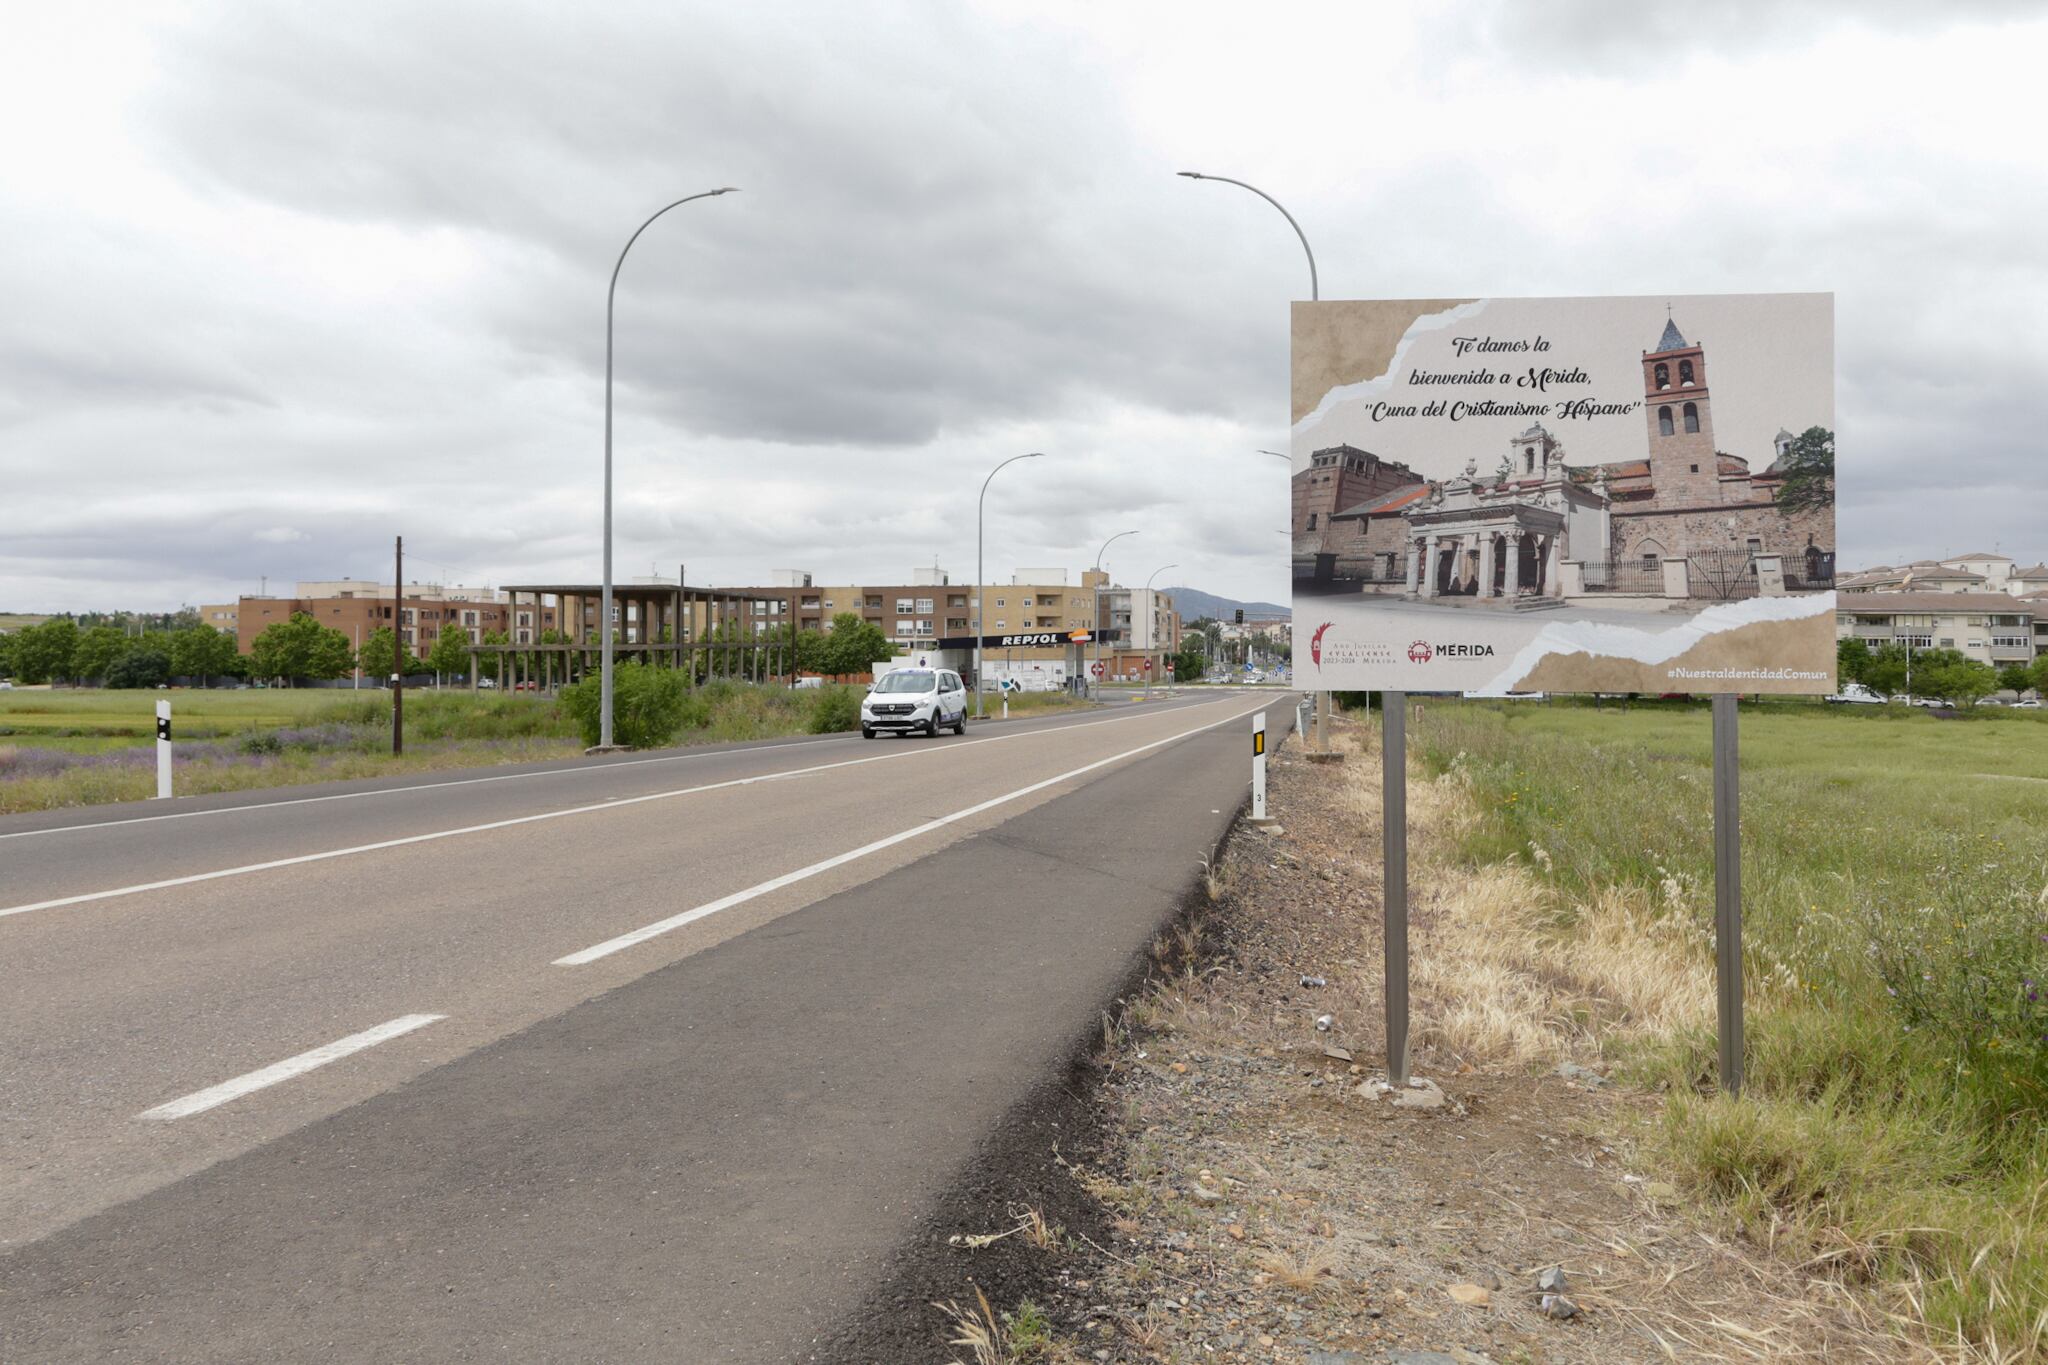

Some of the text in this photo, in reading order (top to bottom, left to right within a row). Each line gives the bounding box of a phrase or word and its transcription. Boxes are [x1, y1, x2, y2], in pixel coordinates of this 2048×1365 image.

[1451, 335, 1552, 358] Te damos la
[1408, 366, 1593, 393] bienvenida a Mérida,
[1364, 397, 1642, 423] "Cuna del Cristianismo Hispano"
[1002, 634, 1058, 645] REPSOL
[1435, 643, 1495, 656] MÉRIDA
[1667, 667, 1828, 680] #NuestraIdentidadComun
[1257, 794, 1262, 802] 3
